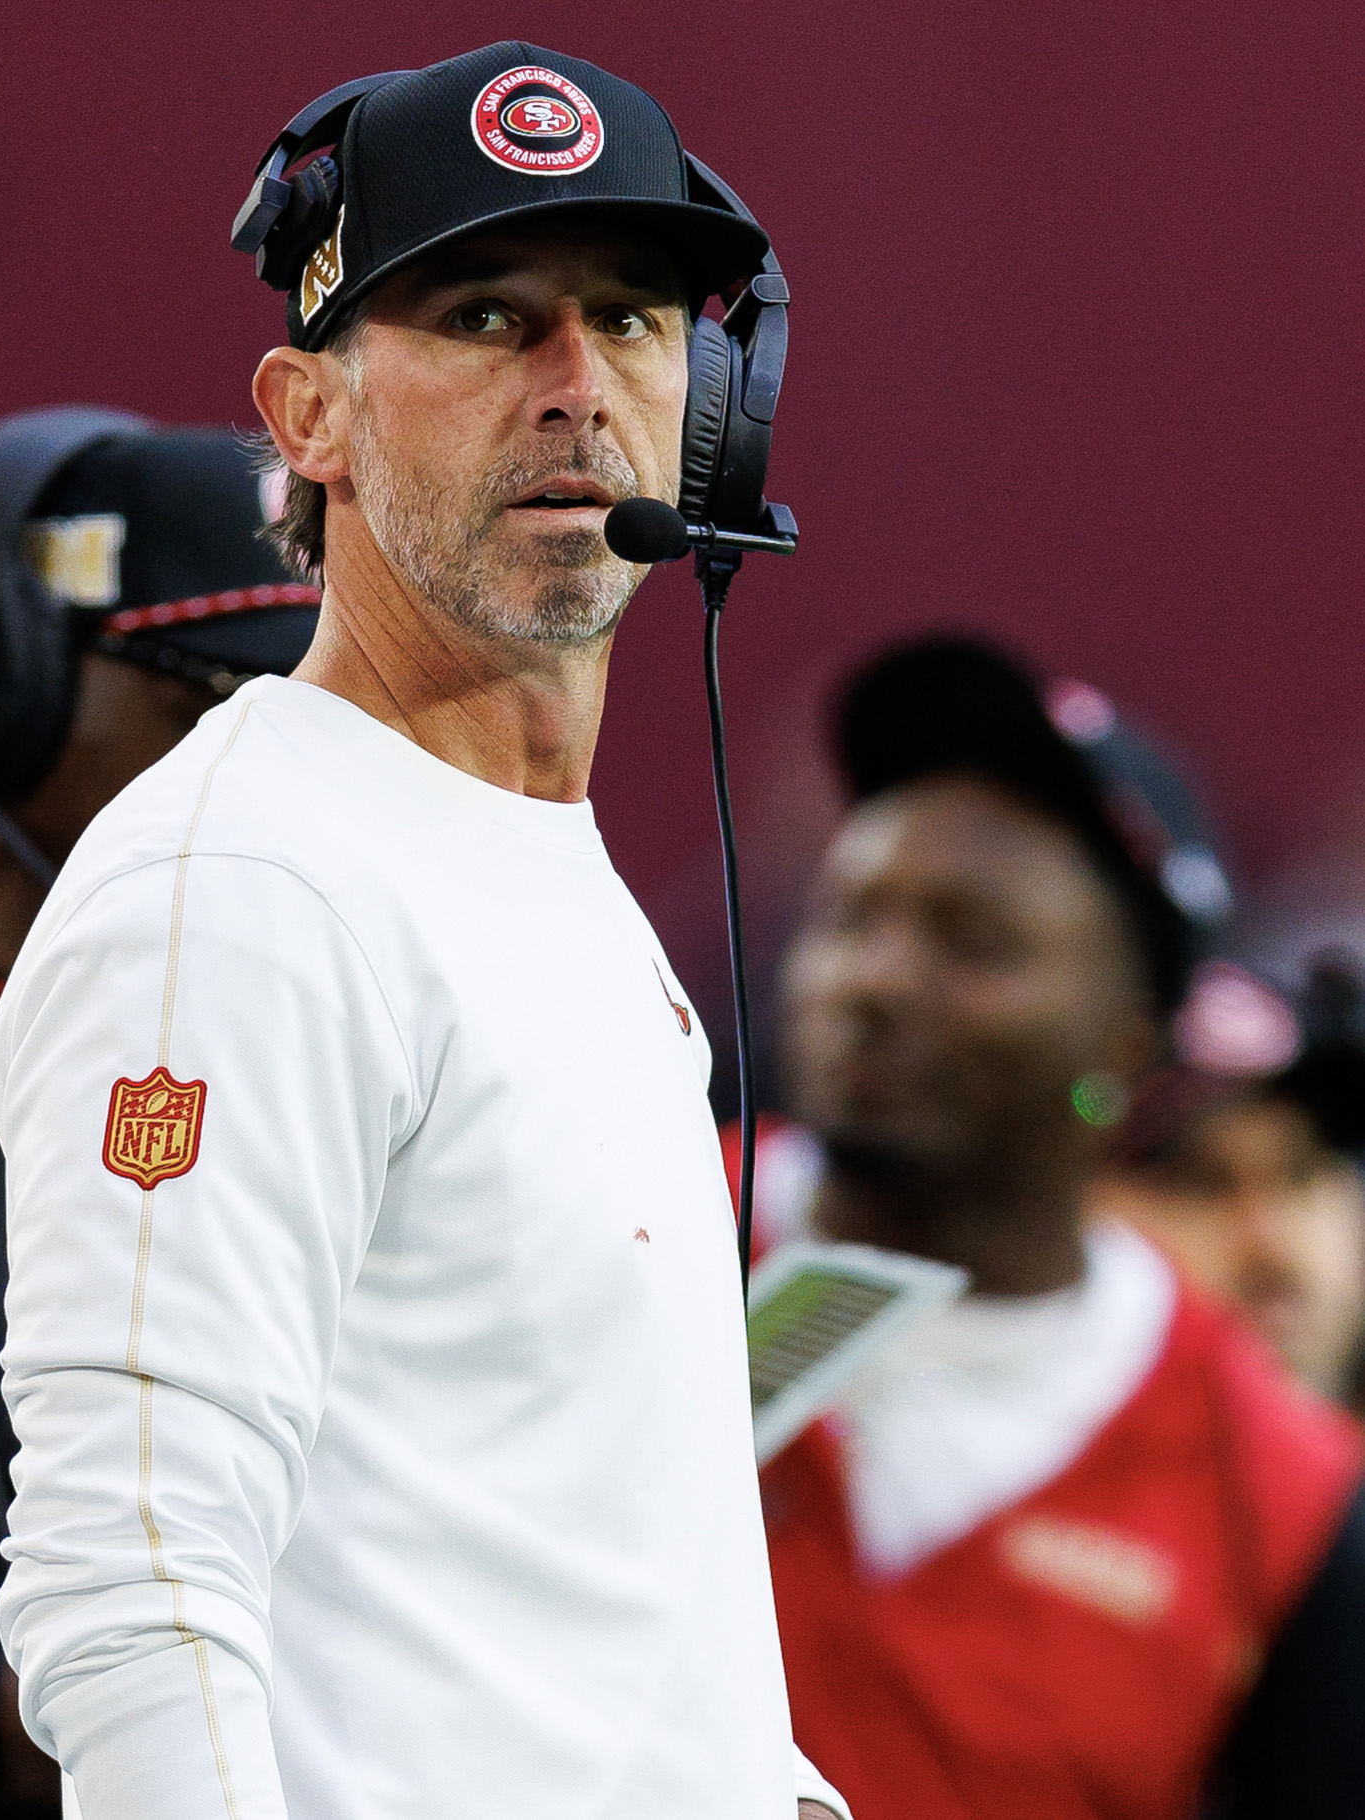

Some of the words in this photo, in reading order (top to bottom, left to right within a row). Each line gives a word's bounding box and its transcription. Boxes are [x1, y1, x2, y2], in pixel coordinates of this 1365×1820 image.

[483, 89, 502, 112] SAN
[497, 70, 562, 93] FRANCISCO
[563, 84, 592, 115] 49ERS
[524, 102, 567, 131] SF
[486, 129, 508, 150] SAN
[504, 148, 574, 165] FRANCISCO
[573, 131, 596, 158] 49ERS
[120, 1121, 181, 1165] NFL
